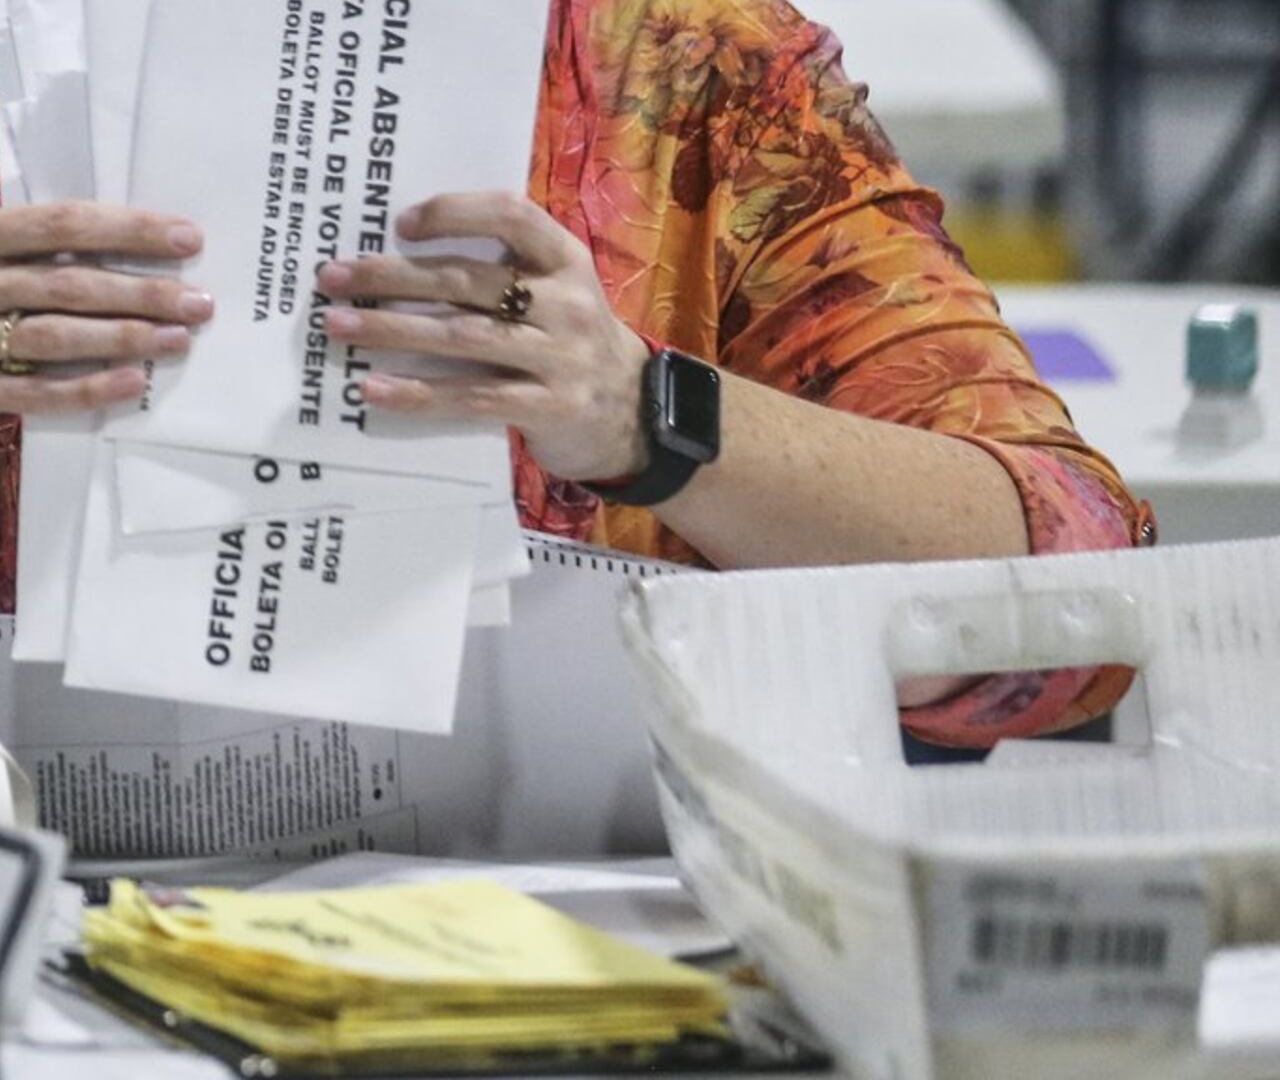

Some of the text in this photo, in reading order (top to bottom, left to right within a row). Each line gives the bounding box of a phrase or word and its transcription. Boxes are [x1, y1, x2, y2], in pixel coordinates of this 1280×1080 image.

[272, 87, 292, 146] DEBE
[328, 30, 361, 144] OFICIAL
[263, 151, 286, 219] ESTAR
[278, 10, 326, 316] BALLOT MUST BE ENCLOSED
[322, 154, 347, 194] DE
[357, 86, 401, 258] ABSENTE
[252, 225, 278, 323] ADJUNTA
[298, 289, 332, 427] AUSENTE
[339, 294, 378, 433] BLOT
[205, 525, 246, 667] OFFICIA
[298, 517, 321, 571] BALL
[321, 515, 345, 585] BOLET
[249, 560, 284, 674] BOLETA
